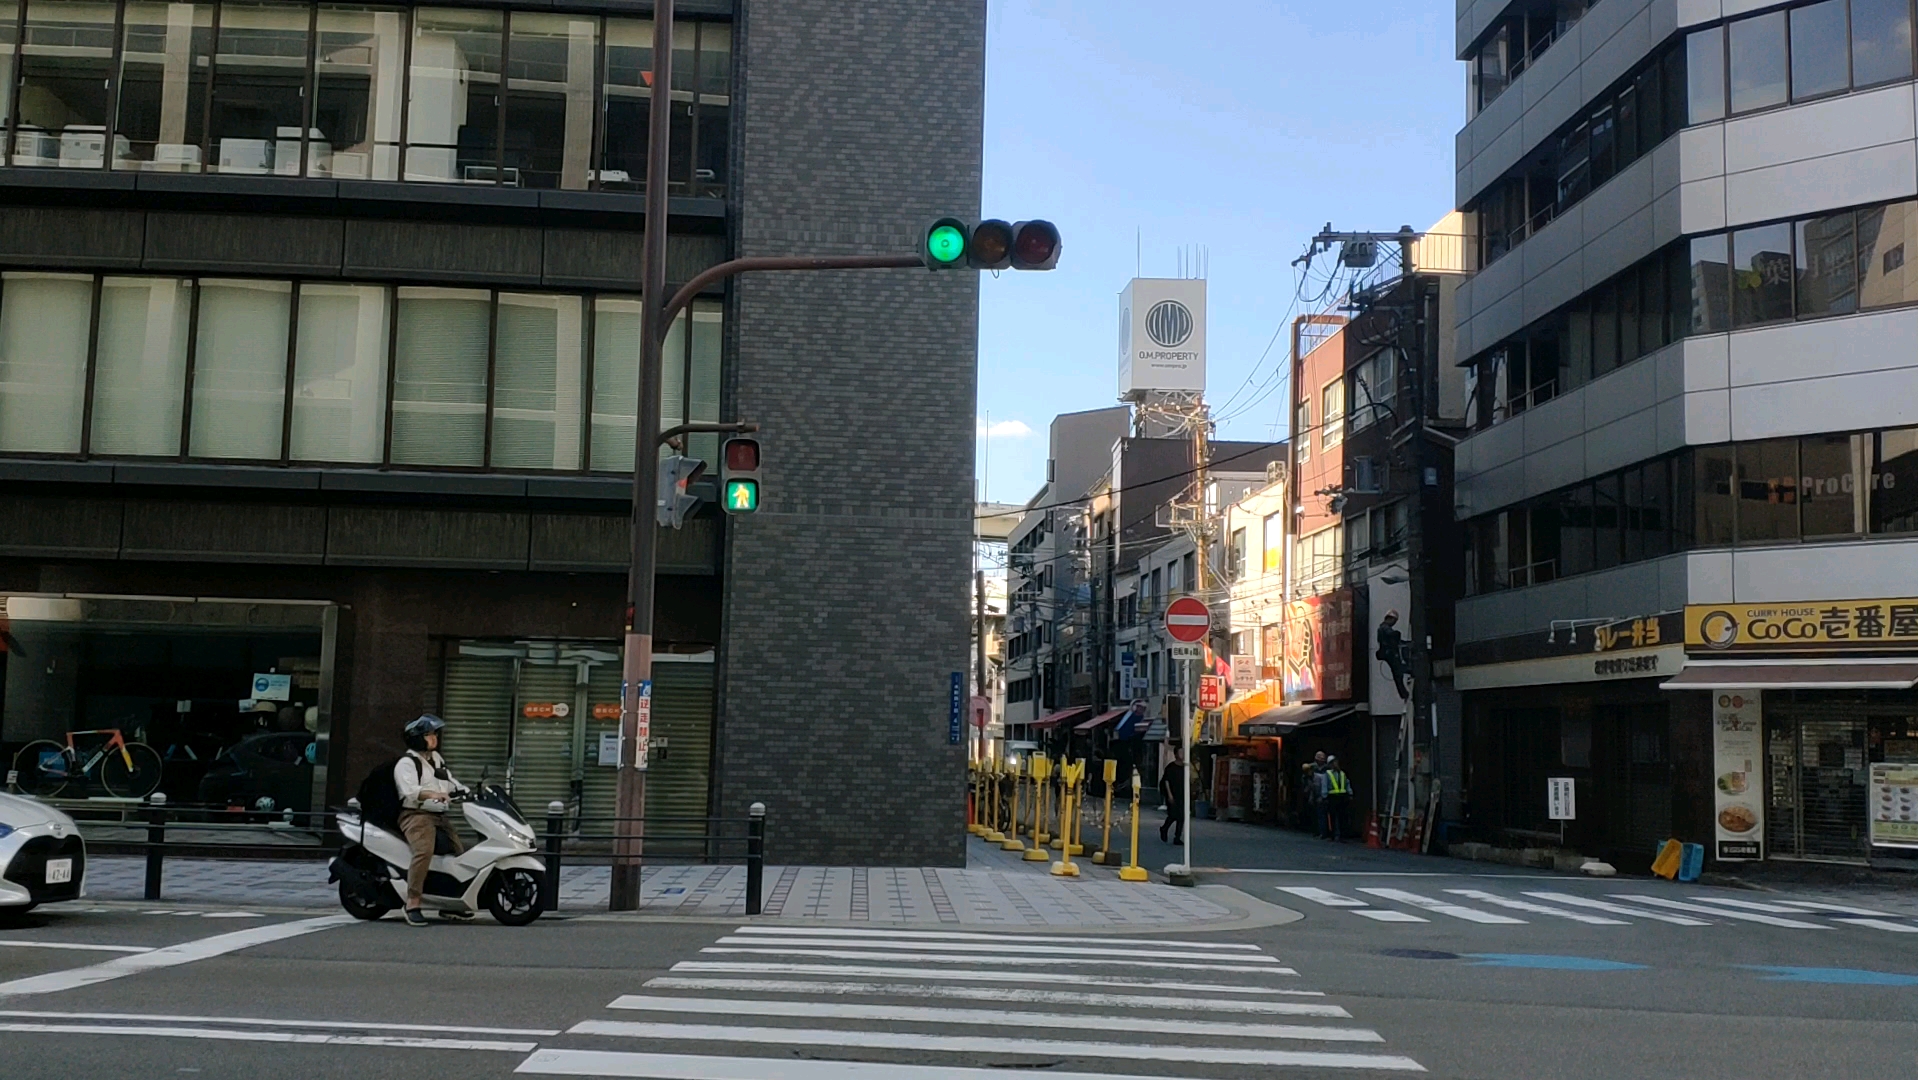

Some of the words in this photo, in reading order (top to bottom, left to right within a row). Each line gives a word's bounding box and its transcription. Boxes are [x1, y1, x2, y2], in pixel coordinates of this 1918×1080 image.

[1802, 472, 1895, 495] ProCre
[1747, 609, 1777, 617] CURRY
[1781, 608, 1815, 616] HOUSE
